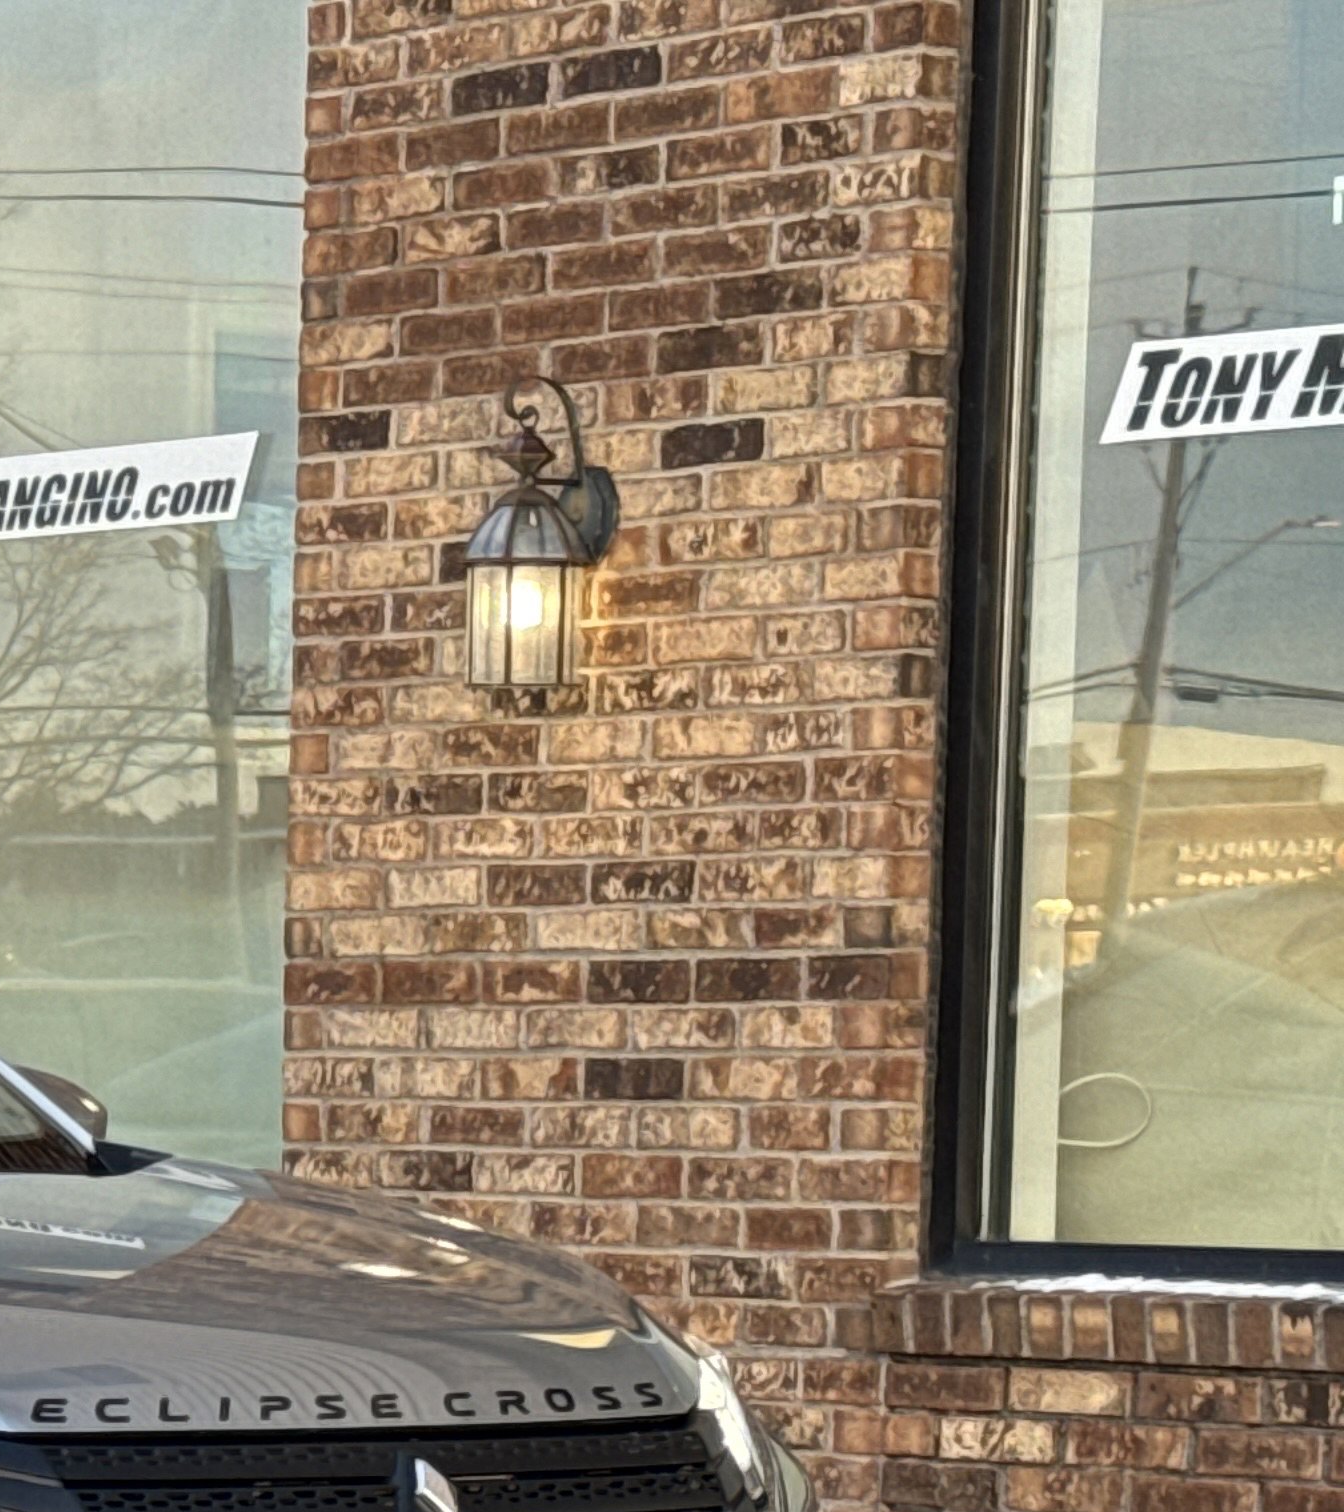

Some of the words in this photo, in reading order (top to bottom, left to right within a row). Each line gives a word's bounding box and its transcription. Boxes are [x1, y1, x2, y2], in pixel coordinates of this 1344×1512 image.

[1127, 347, 1303, 432] TONY
[29, 1392, 402, 1424] ECLIPSE
[443, 1381, 665, 1418] CROSS
